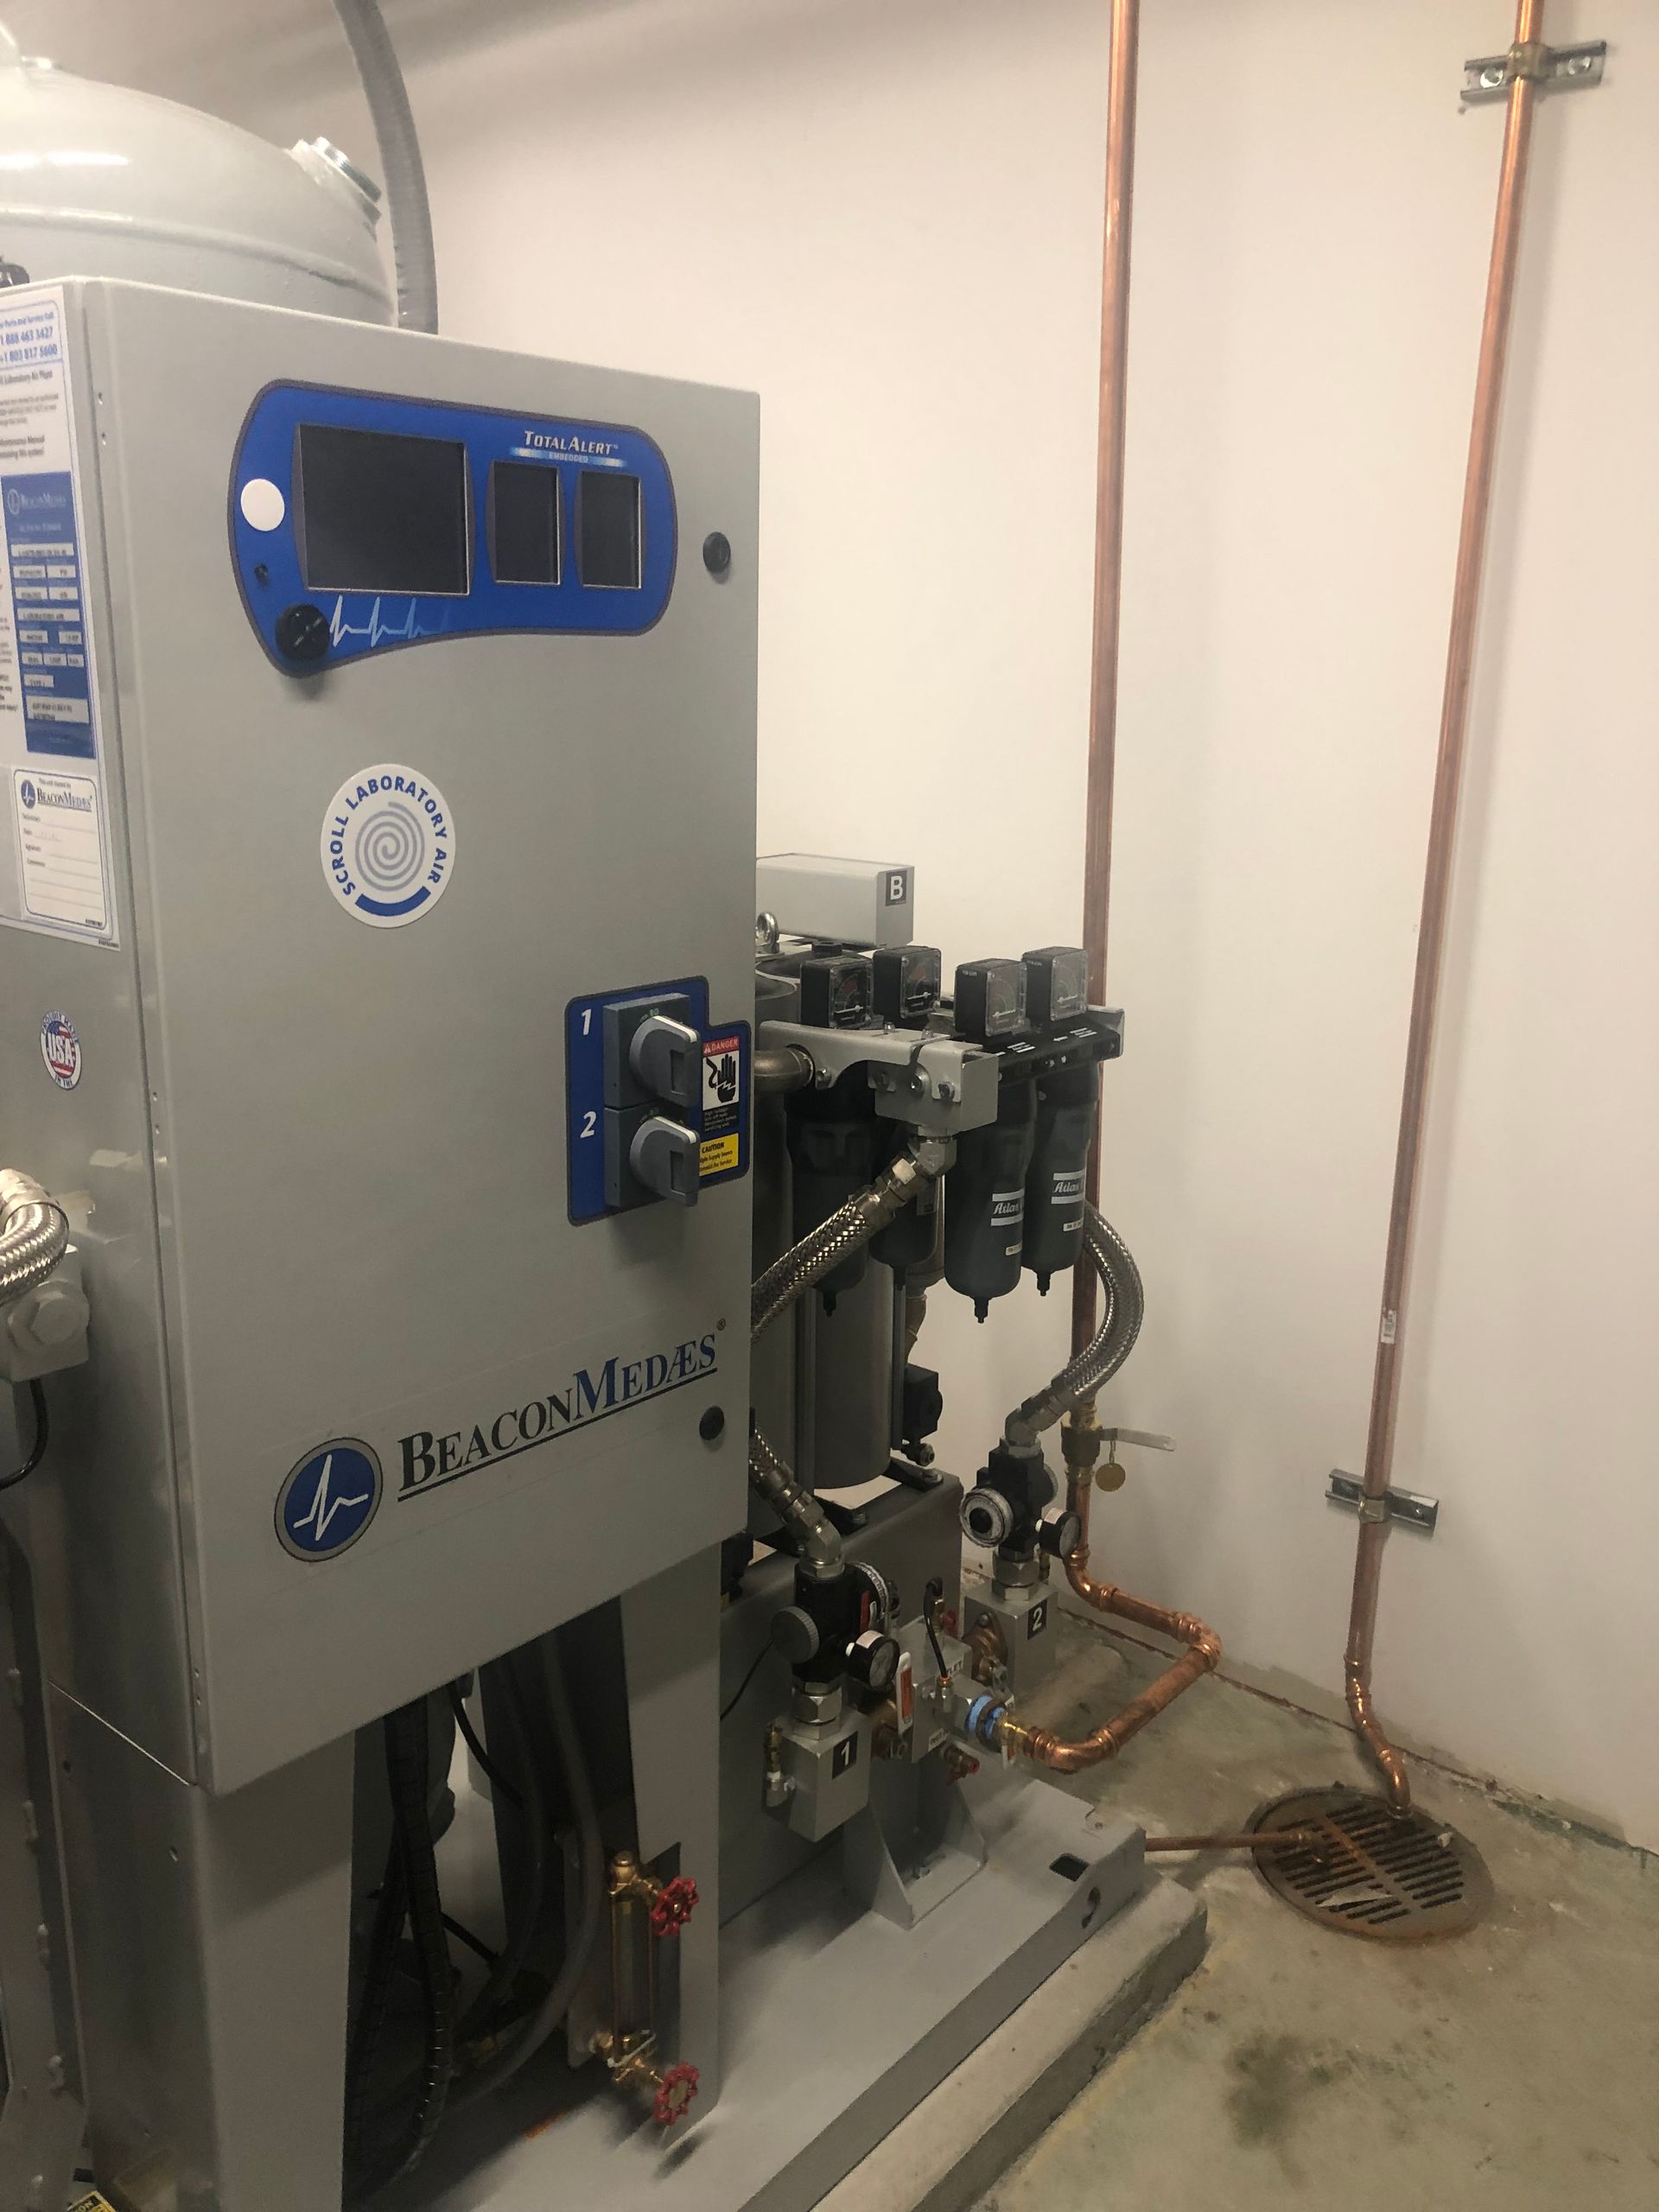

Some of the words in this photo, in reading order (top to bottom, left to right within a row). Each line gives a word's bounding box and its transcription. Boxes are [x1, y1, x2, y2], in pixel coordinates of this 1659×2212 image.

[24, 346, 37, 359] 817
[550, 451, 588, 463] EMBEDDED
[330, 816, 356, 895] SCROLL
[346, 775, 448, 838] LABORATORY
[428, 848, 448, 883] AIR
[890, 875, 903, 900] B
[582, 1008, 592, 1035] 1
[48, 1031, 74, 1068] USA
[711, 1038, 739, 1052] DANGER
[580, 1110, 597, 1138] 2
[702, 1141, 725, 1154] CAUTION
[1053, 1181, 1078, 1193] Atlas
[1032, 1607, 1042, 1631] 2
[841, 1740, 850, 1766] 1
